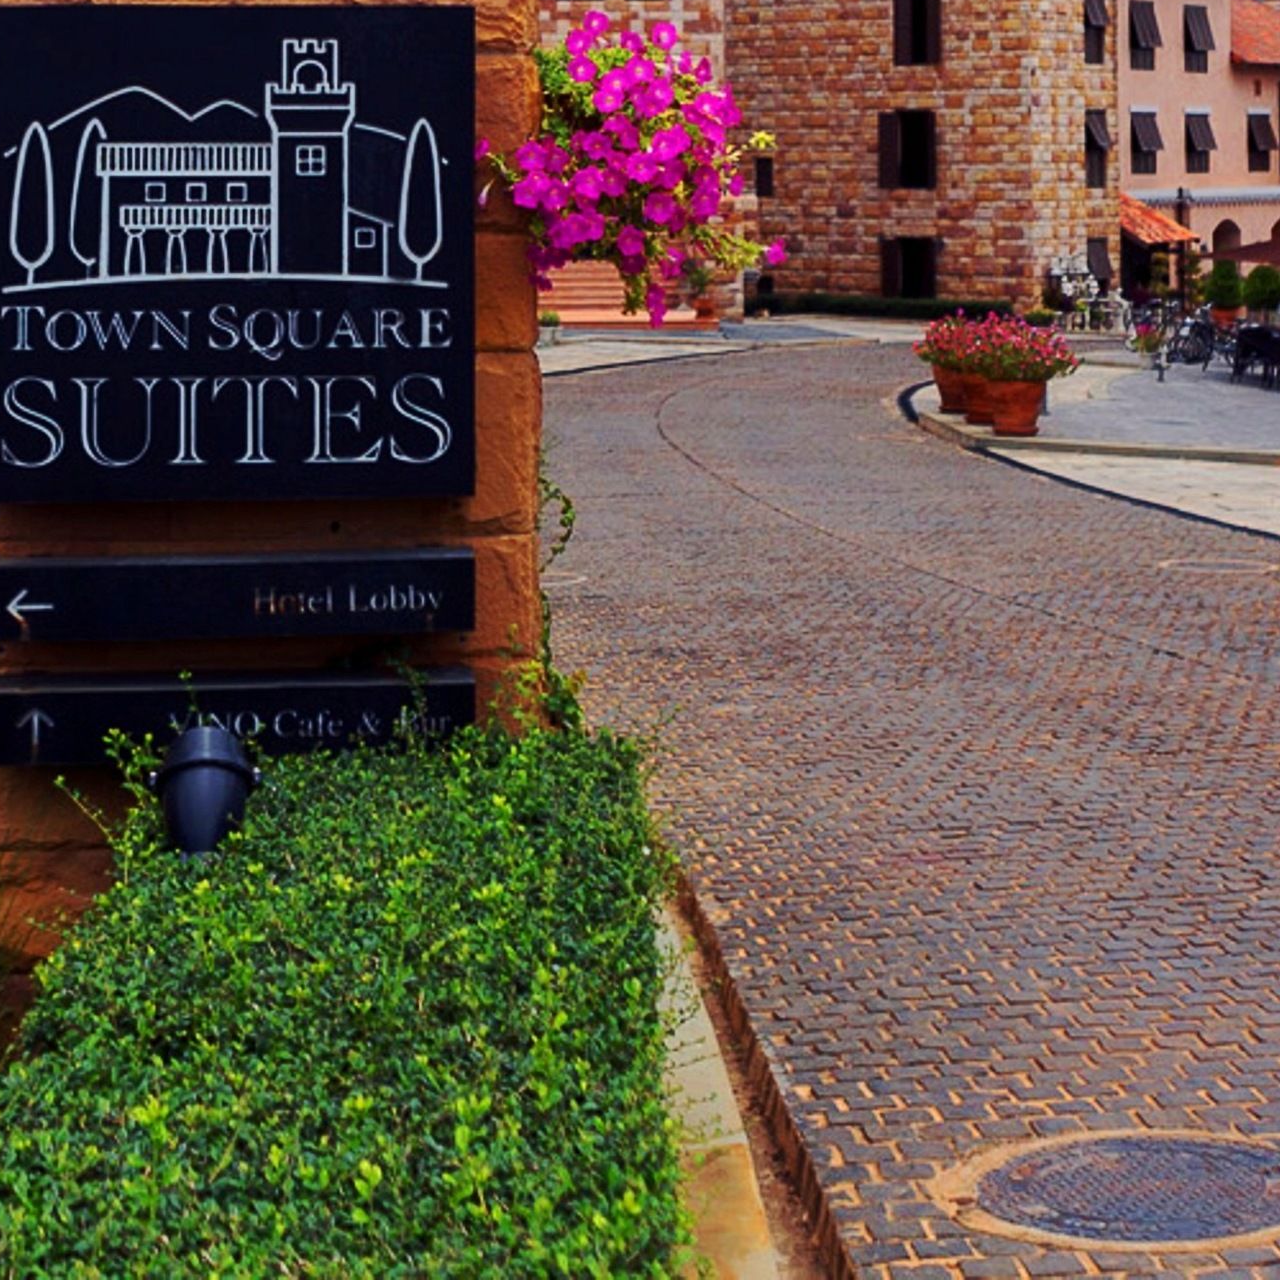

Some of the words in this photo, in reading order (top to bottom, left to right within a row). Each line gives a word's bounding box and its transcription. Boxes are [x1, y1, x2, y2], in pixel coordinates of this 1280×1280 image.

[1, 304, 192, 352] TOWN
[207, 303, 453, 361] SQUARE
[0, 372, 453, 468] SUITES
[253, 585, 334, 615] Hotel
[348, 583, 443, 615] Lobby
